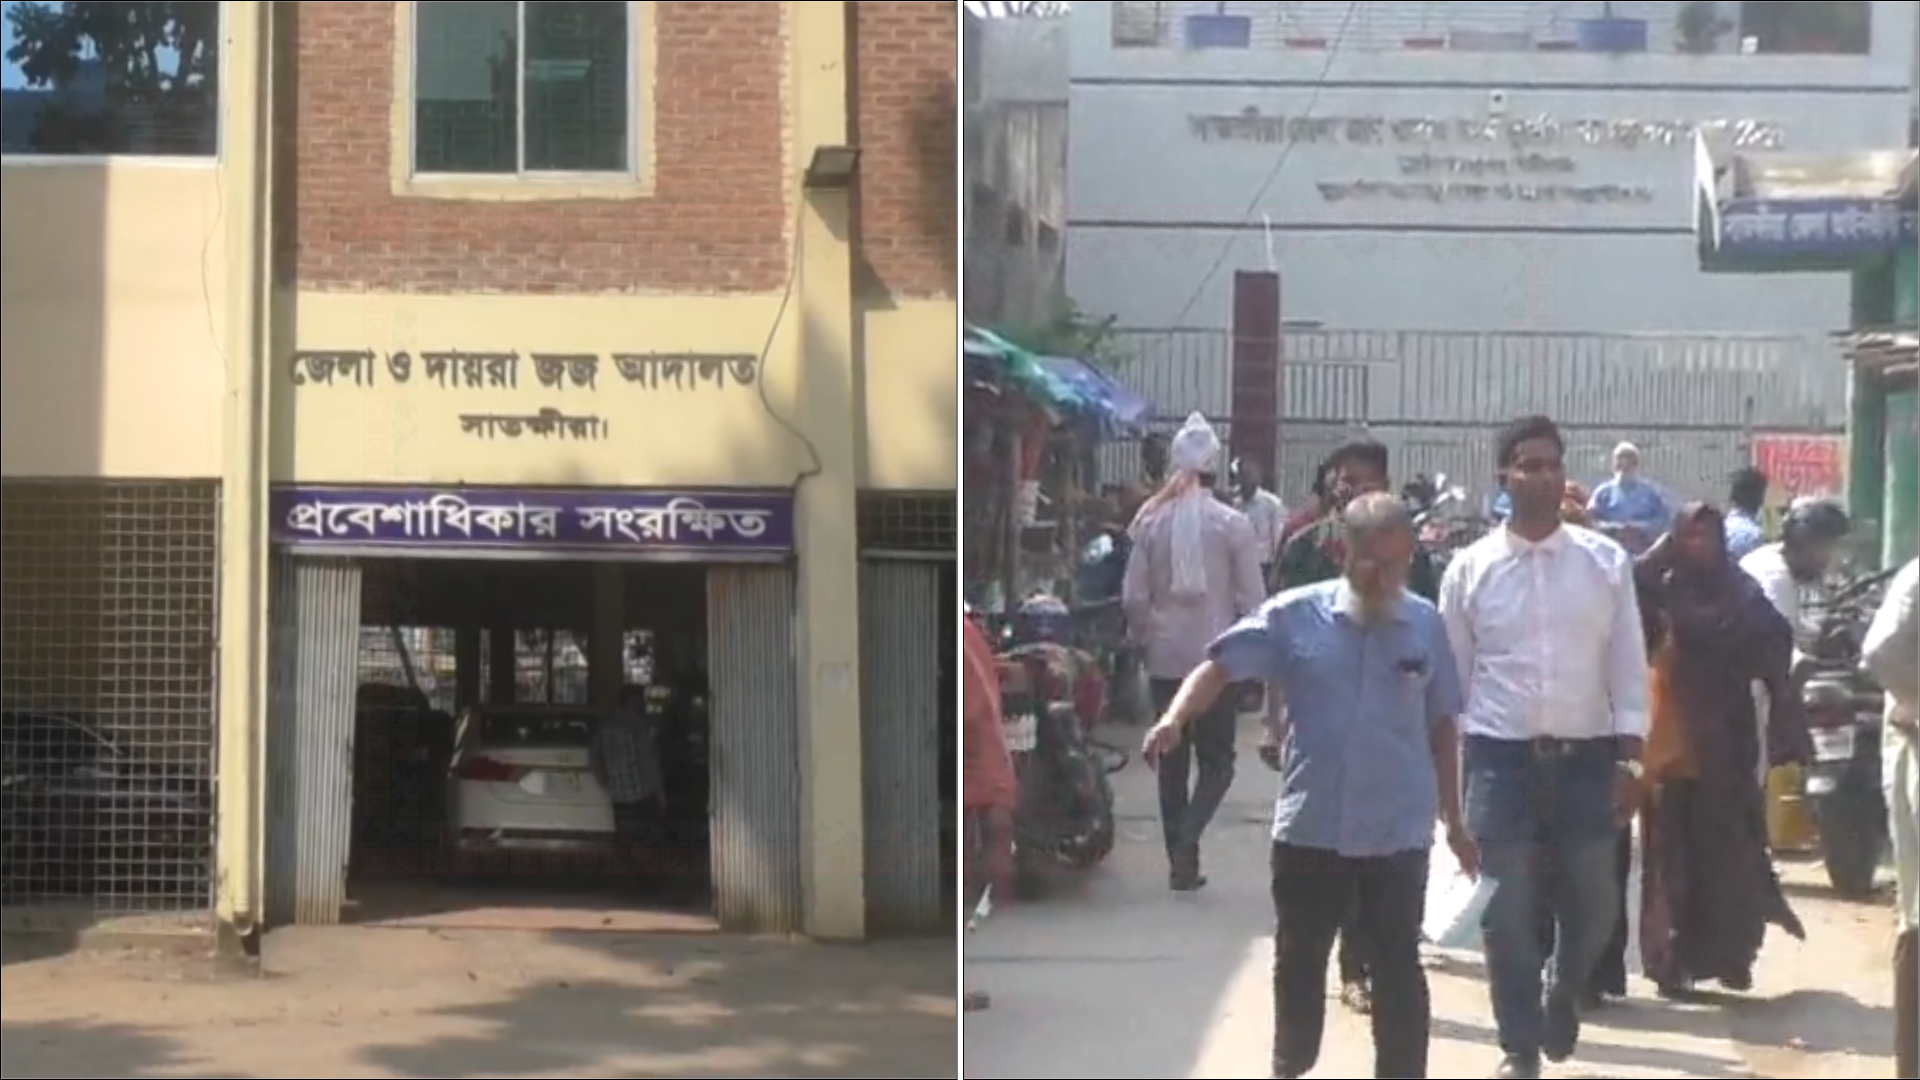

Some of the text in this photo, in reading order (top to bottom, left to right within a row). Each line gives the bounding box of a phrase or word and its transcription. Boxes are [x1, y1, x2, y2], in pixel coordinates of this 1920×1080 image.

[287, 348, 758, 391] জেলা ও দায়রা জজ আদালত
[287, 493, 773, 542] প্রবেশাধিকার সংরক্ষিত
